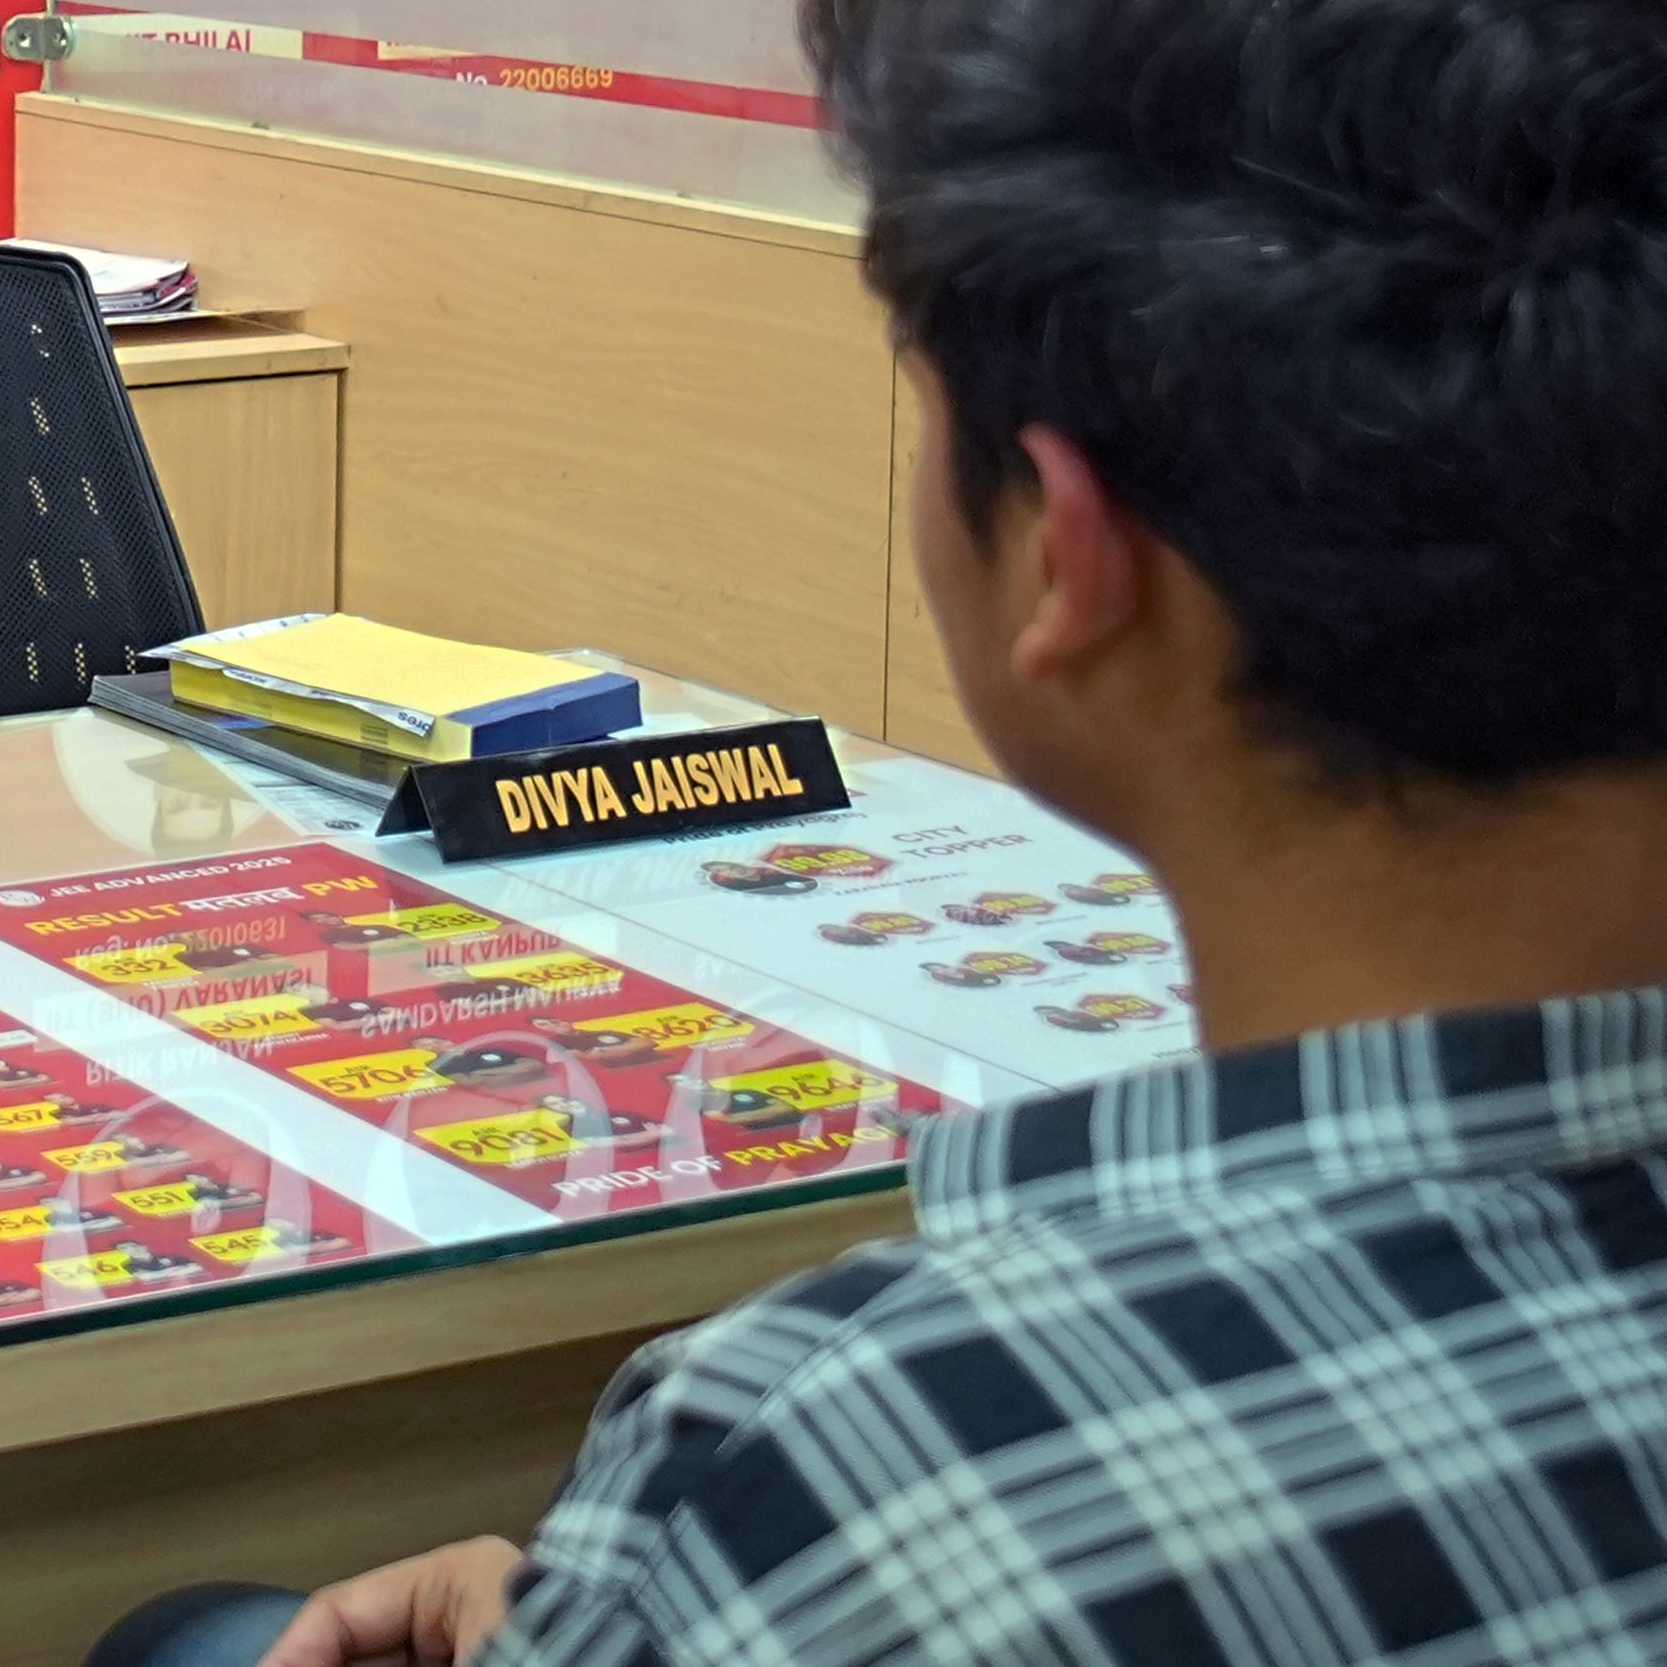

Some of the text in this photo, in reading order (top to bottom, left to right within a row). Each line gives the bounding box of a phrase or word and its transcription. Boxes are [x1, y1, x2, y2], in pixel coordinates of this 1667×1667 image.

[495, 743, 804, 833] DIVYA JAISWAL
[24, 902, 182, 937] RESULT
[551, 1164, 674, 1200] PRIDE
